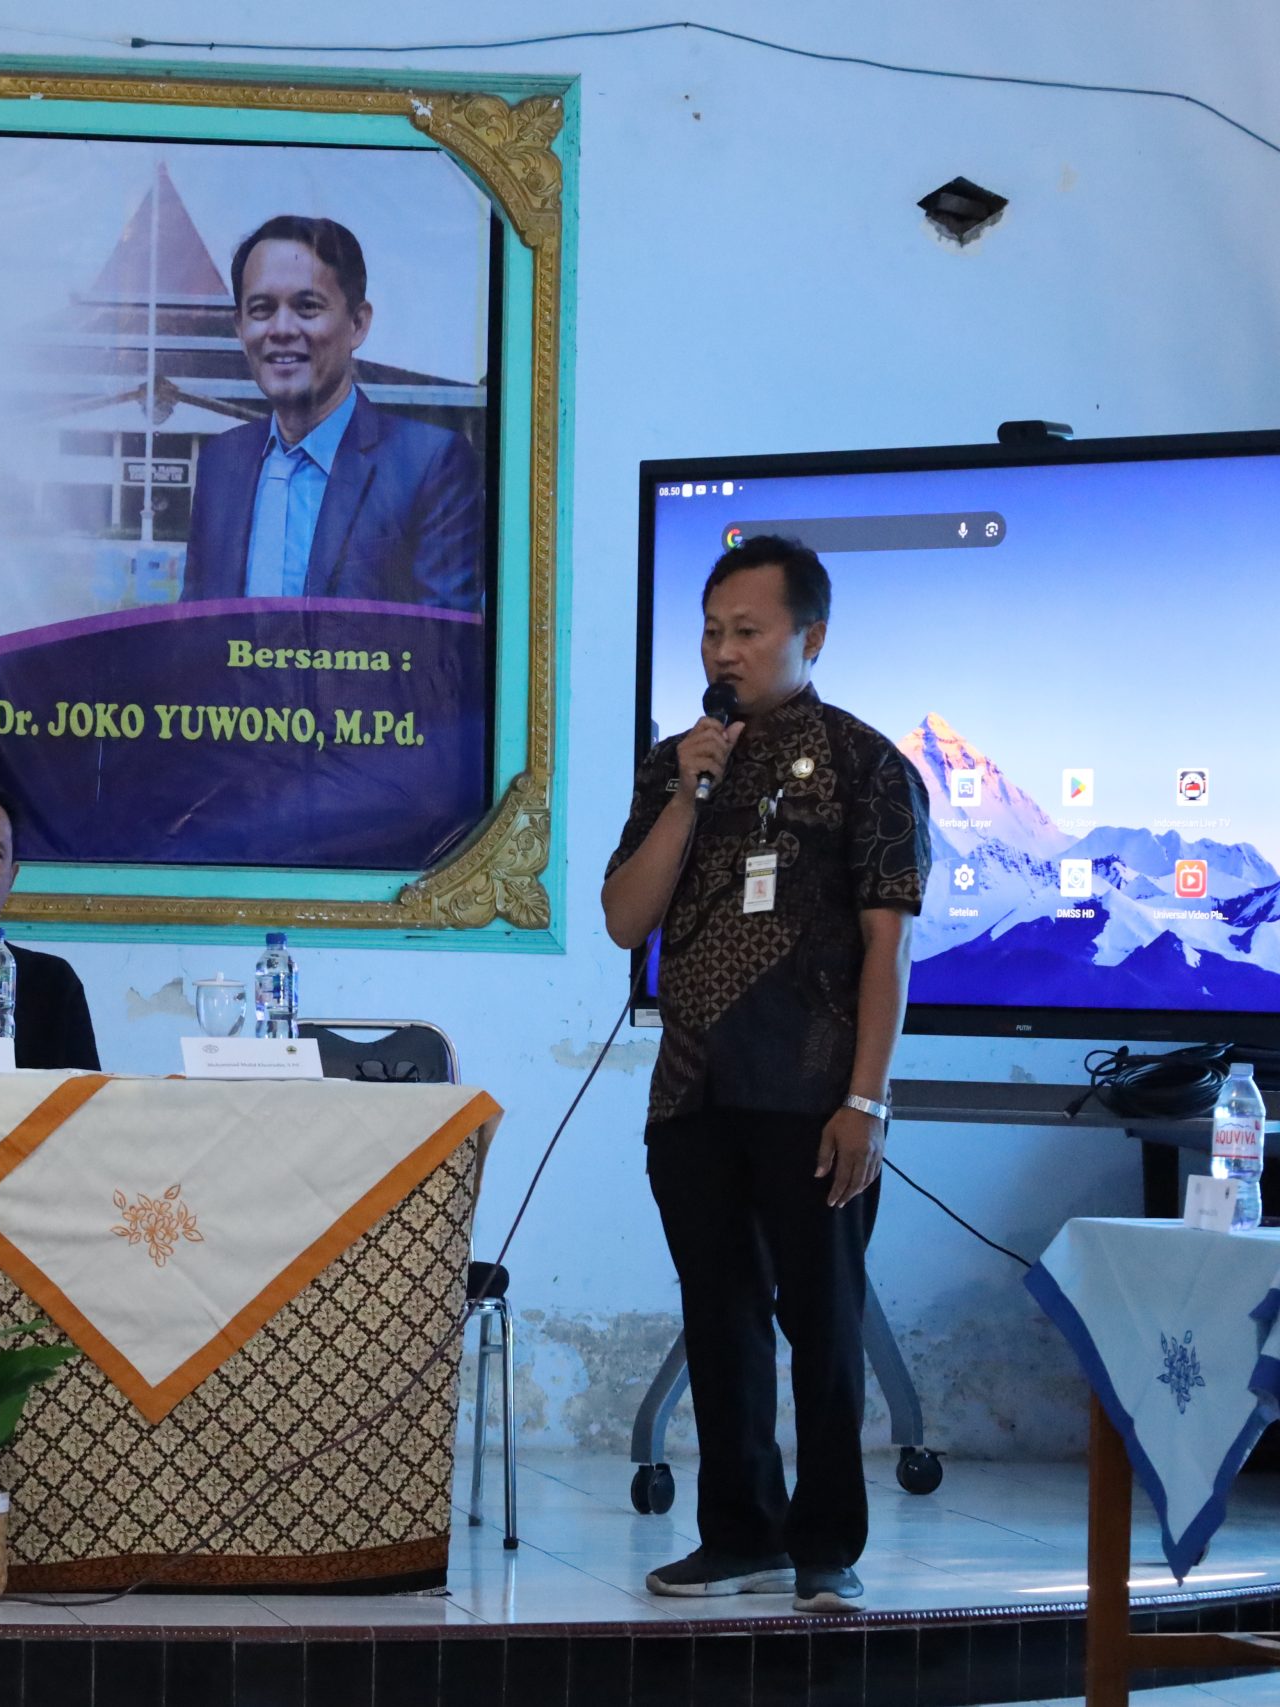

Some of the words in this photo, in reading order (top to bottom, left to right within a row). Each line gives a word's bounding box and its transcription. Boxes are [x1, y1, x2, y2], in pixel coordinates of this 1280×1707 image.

[227, 640, 391, 671] Bersama
[47, 702, 145, 739] JOKO
[153, 705, 324, 751] YUWONO,
[334, 709, 424, 746] M.Pd.
[949, 907, 978, 917] Setelan
[1056, 909, 1081, 918] DMSS
[1082, 909, 1095, 918] HD
[1188, 910, 1210, 919] Video
[1215, 1130, 1257, 1146] AQUVIVA
